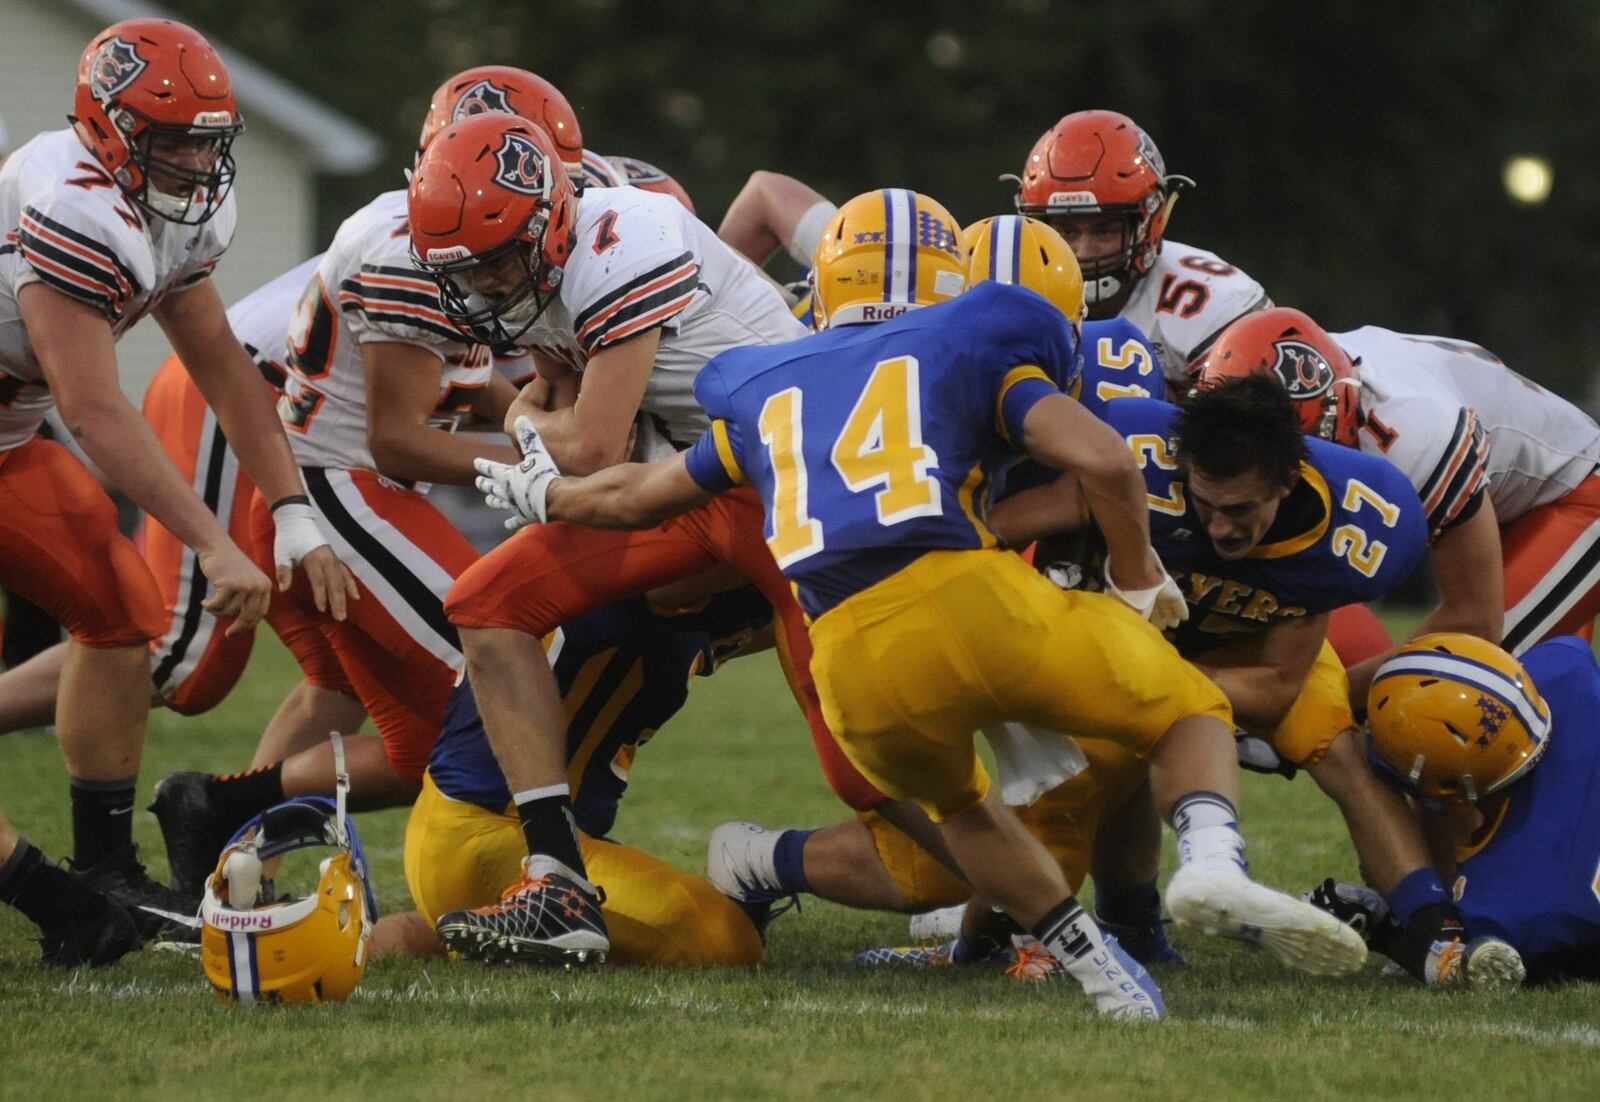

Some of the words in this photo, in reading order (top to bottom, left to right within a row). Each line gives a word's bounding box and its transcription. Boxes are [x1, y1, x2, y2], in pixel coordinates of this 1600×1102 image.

[1096, 336, 1154, 402] 15
[758, 354, 943, 570] 14
[1126, 433, 1187, 517] 27
[1331, 478, 1401, 579] 27
[212, 912, 273, 929] Riddell
